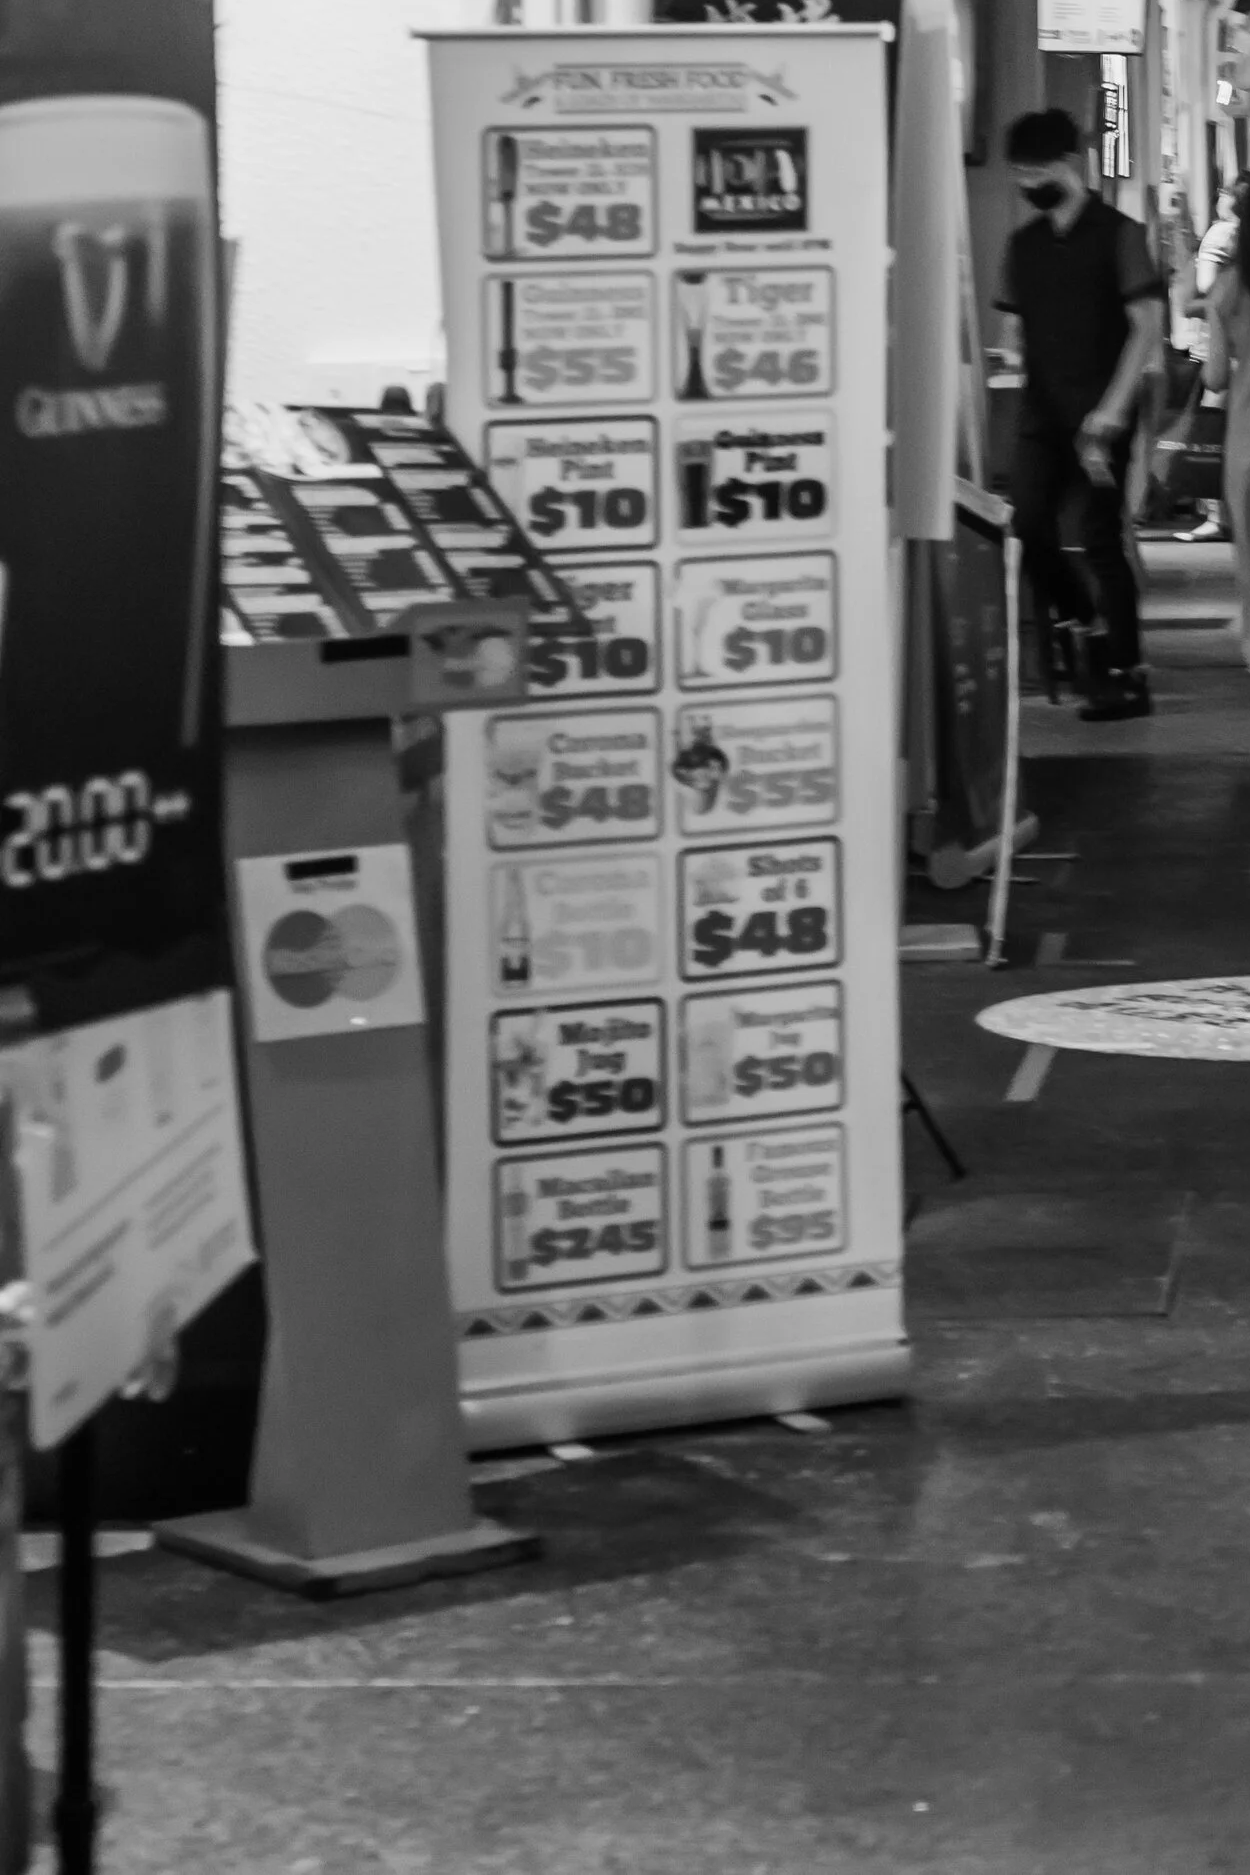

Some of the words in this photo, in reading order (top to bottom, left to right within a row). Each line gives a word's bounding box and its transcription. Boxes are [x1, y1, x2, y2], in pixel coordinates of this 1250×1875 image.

[525, 200, 642, 247] $48
[722, 274, 814, 311] Tiger
[524, 345, 638, 393] $55
[713, 347, 821, 391] $46
[527, 486, 647, 537] $10
[713, 477, 826, 529] $10
[529, 637, 649, 688] $10
[723, 626, 828, 673] $10
[540, 783, 652, 830] $48
[727, 768, 835, 815] $55
[533, 927, 653, 980] $10
[692, 906, 828, 968] $48
[733, 1052, 838, 1098] $50
[547, 1077, 655, 1124] $50
[531, 1220, 659, 1266] $245
[749, 1210, 837, 1252] $95
